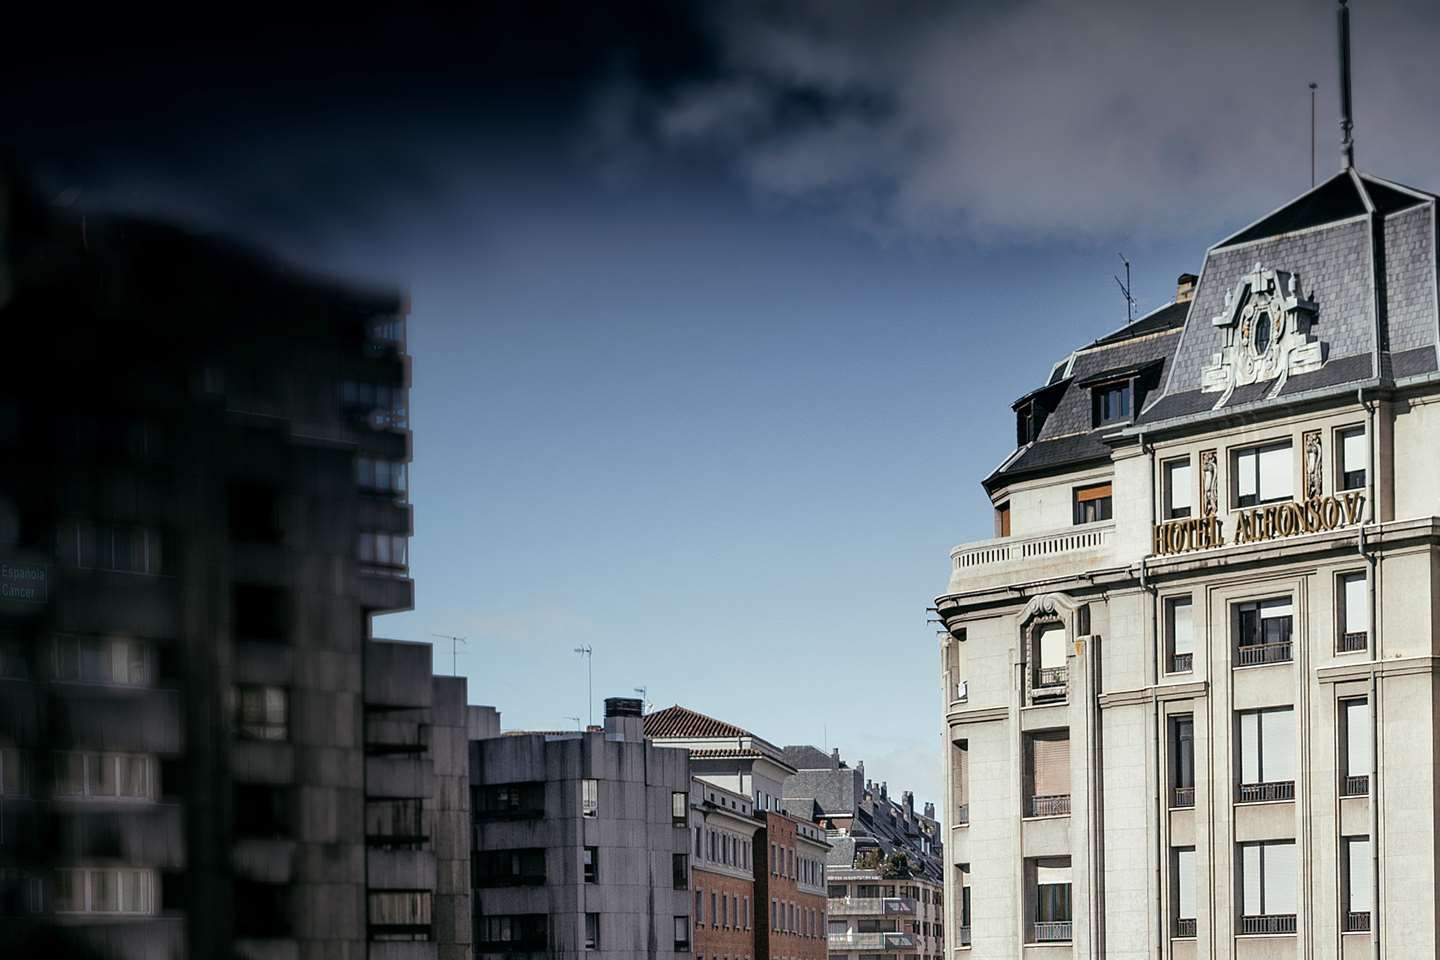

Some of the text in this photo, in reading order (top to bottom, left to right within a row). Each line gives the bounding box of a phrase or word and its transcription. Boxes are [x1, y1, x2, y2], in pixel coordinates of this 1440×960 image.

[1152, 491, 1361, 554] HOTEL ALFONSO V
